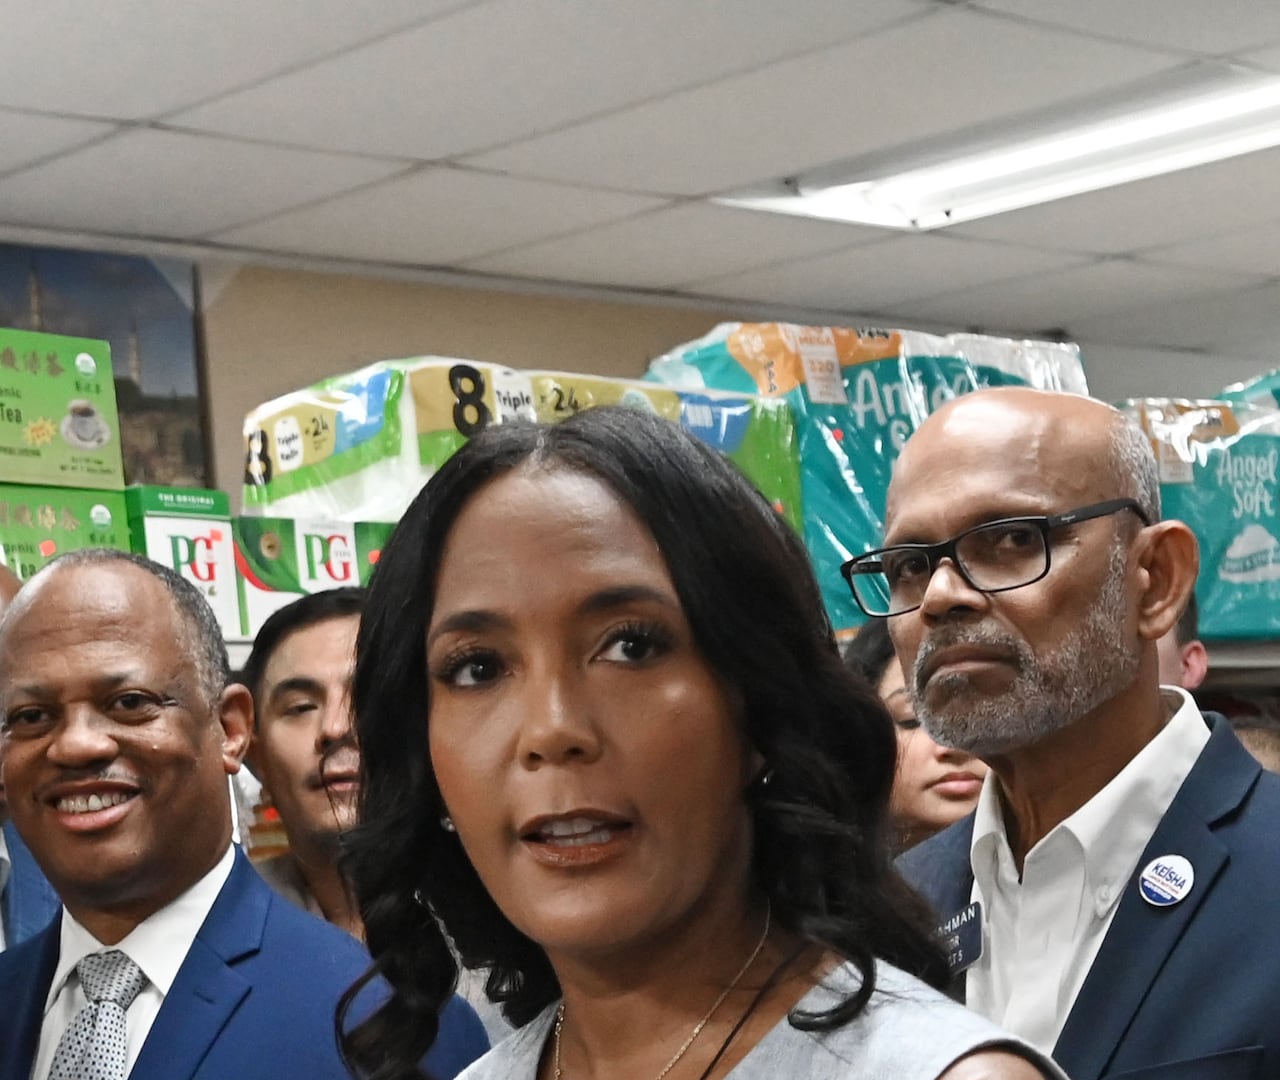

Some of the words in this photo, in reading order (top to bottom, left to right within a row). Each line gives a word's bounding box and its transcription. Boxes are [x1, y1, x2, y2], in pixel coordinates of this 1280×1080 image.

[449, 365, 487, 438] 8
[496, 390, 531, 408] Triple
[554, 387, 579, 412] 24
[1216, 449, 1278, 487] Angel
[158, 493, 175, 503] THE
[1232, 481, 1276, 520] Soft
[169, 534, 216, 582] PG
[304, 533, 351, 582] PG
